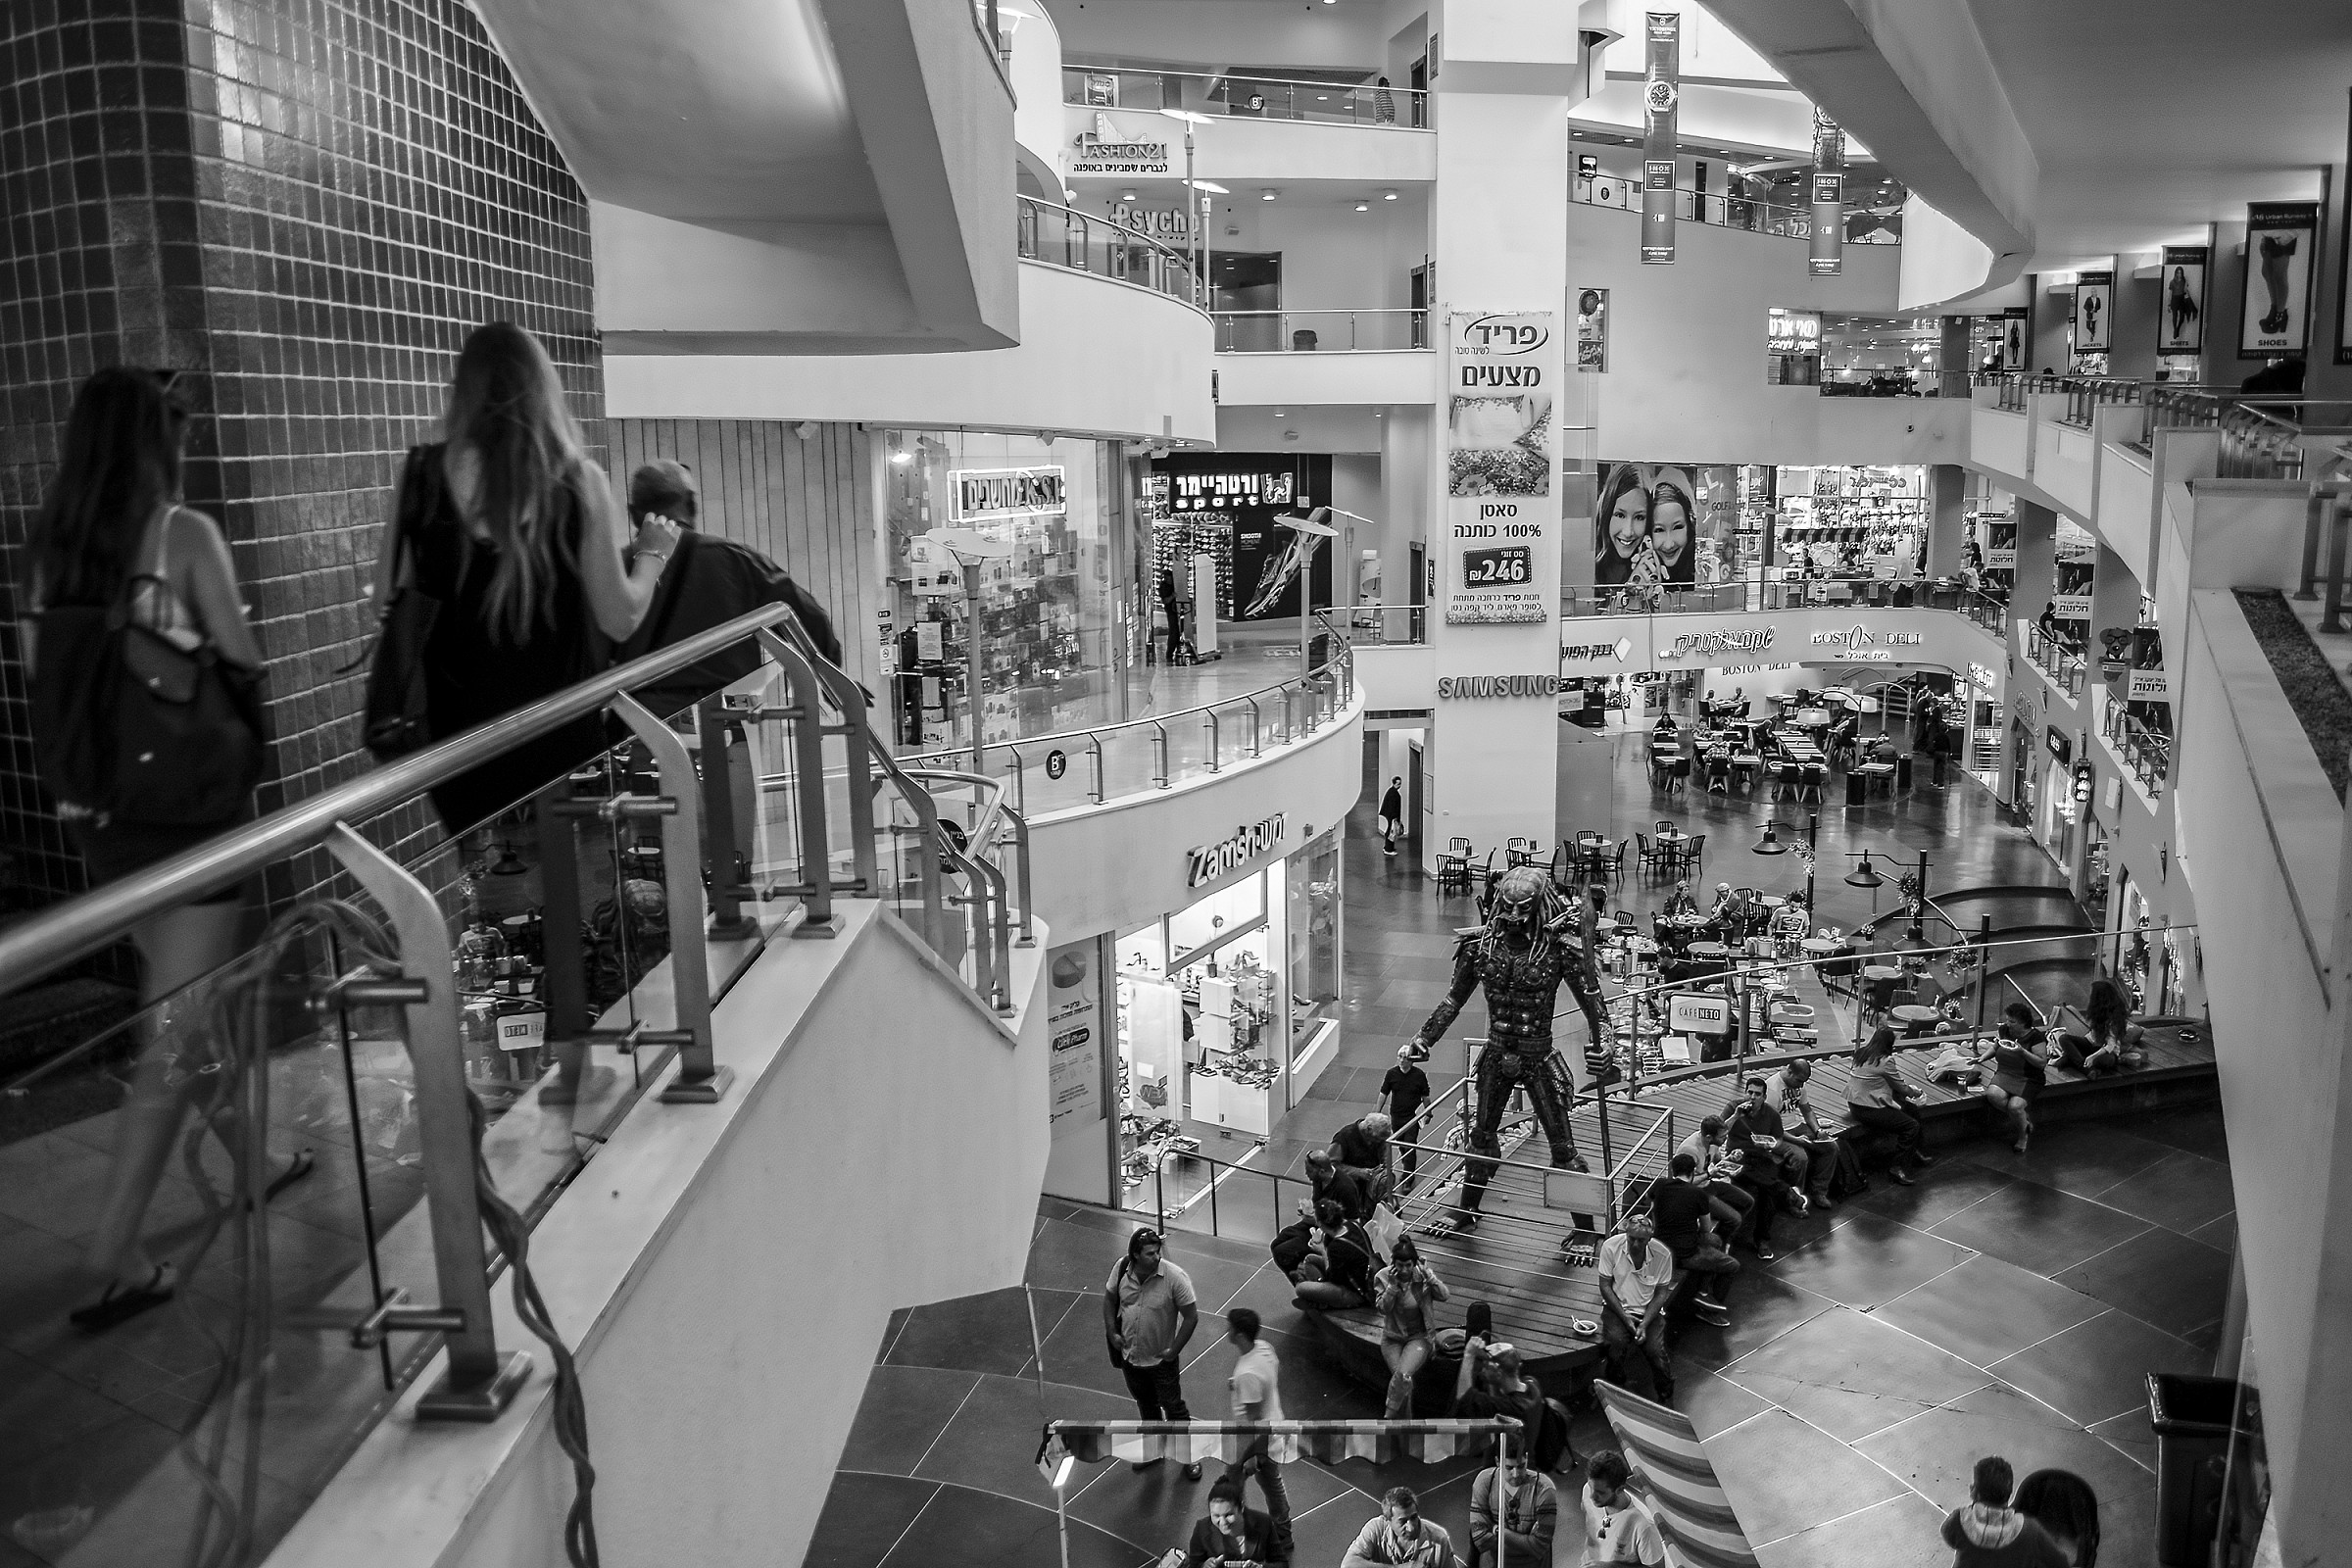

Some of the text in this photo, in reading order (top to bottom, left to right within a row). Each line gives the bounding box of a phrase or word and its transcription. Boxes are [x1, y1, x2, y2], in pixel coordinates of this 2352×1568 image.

[1074, 132, 1167, 158] FASHION21
[1073, 163, 1168, 172] לגברים שמבינים באופנה
[1476, 325, 1538, 344] פריד
[1462, 366, 1541, 387] מצעים
[965, 477, 1023, 510] מחשבים
[1176, 474, 1259, 496] ורטהיימר
[1175, 496, 1259, 510] sport
[1480, 504, 1518, 520] סאטן
[1453, 524, 1542, 537] 100% כותנה
[1812, 625, 1920, 650] BOSTON DELI
[1591, 644, 1613, 662] בנק
[1438, 674, 1560, 699] SAMSUNG
[1187, 826, 1255, 888] Zamsh
[1679, 1006, 1719, 1020] CAFE NETO
